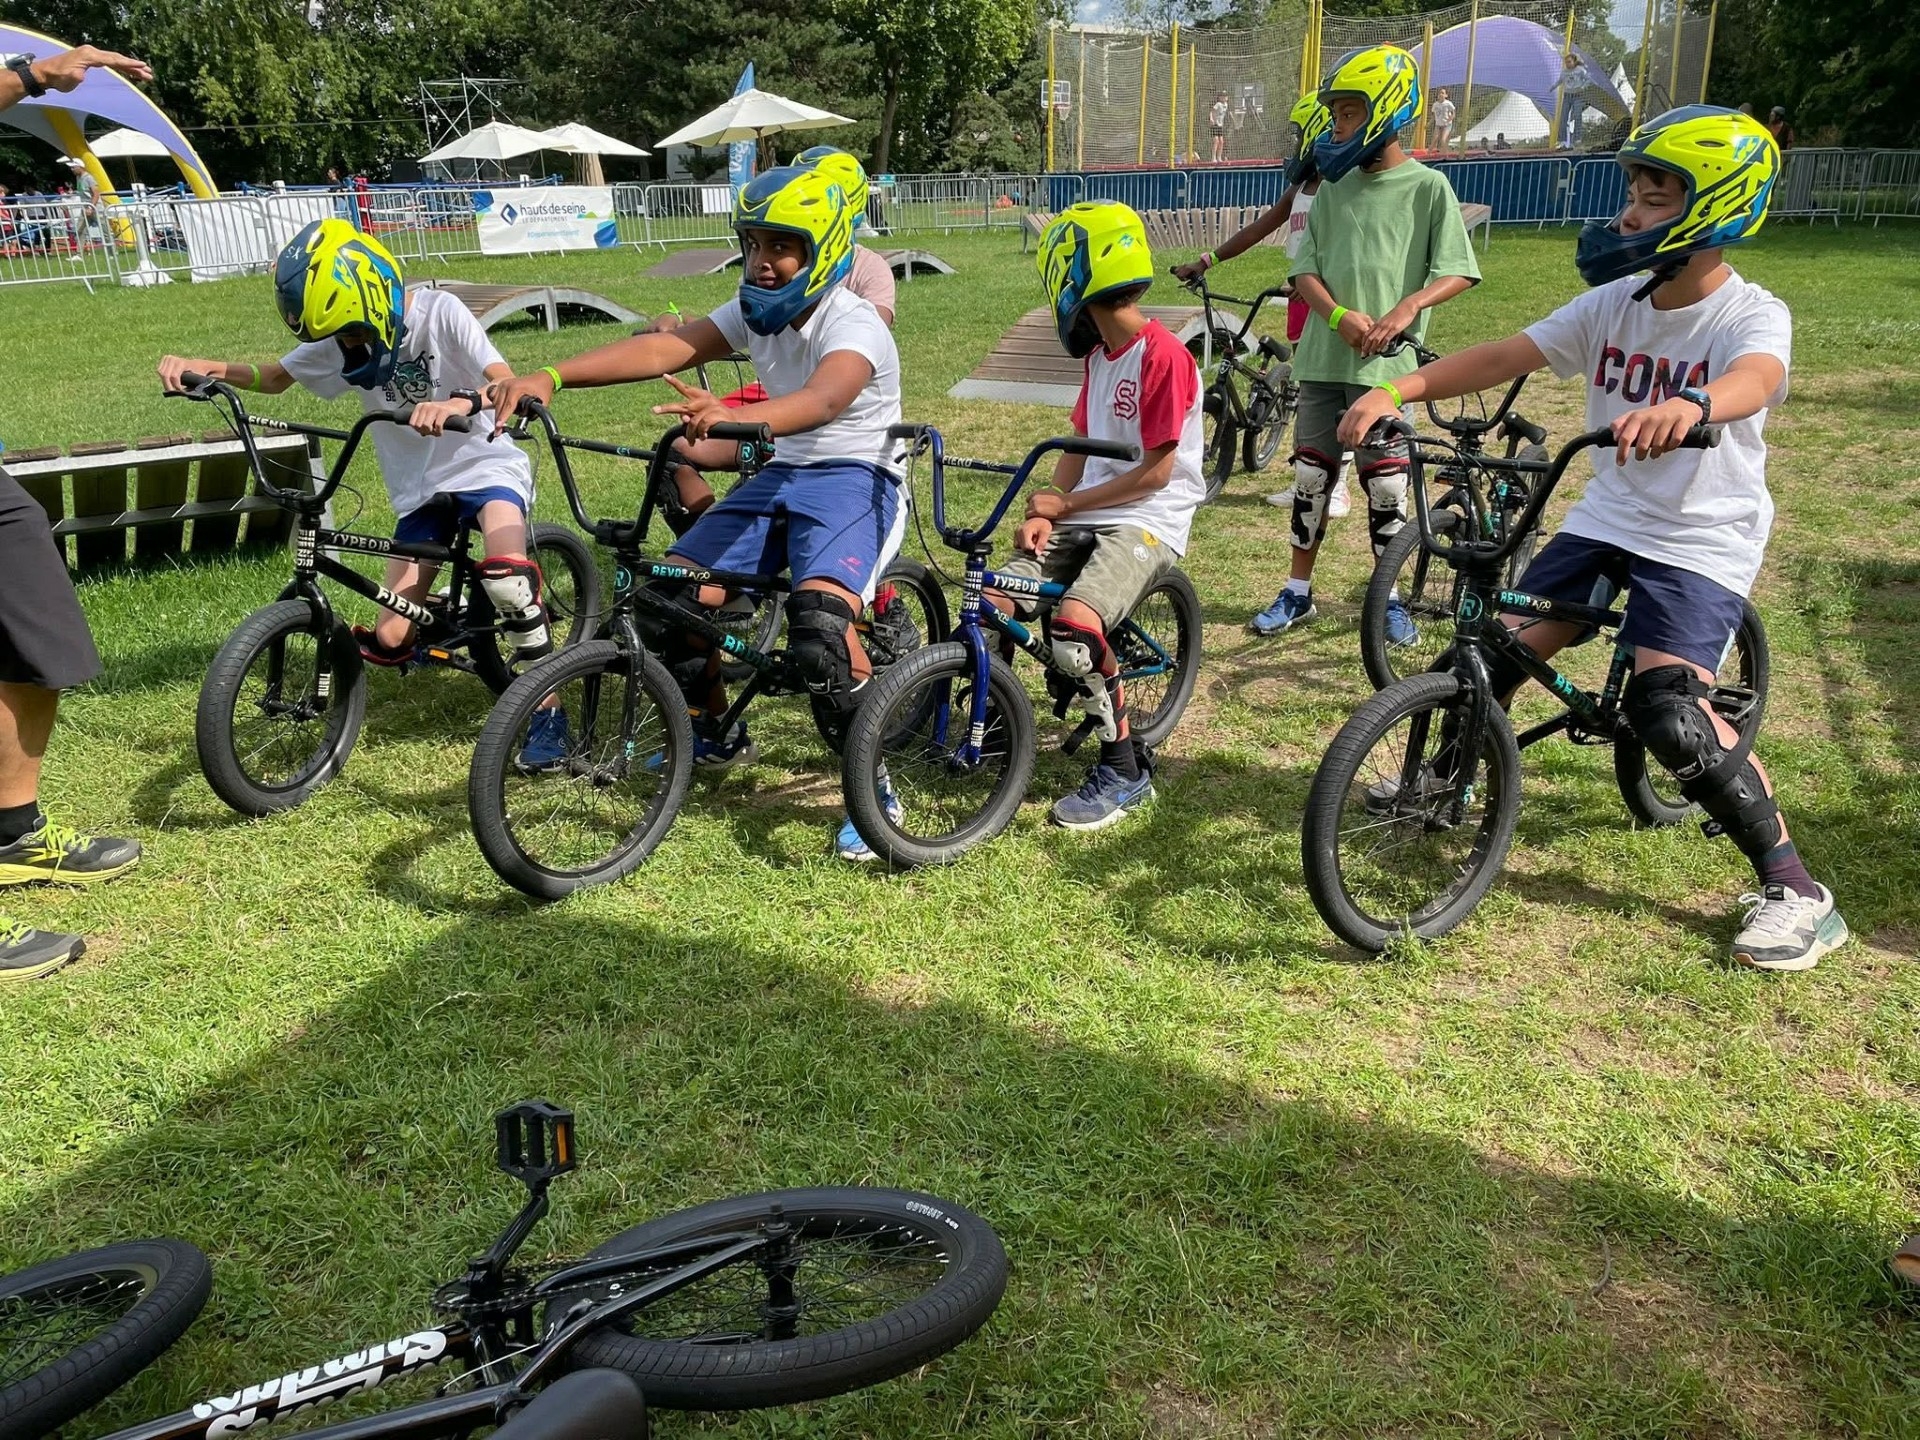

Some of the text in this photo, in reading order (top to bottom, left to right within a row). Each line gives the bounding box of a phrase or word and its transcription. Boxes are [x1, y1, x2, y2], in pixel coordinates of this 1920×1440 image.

[1114, 379, 1138, 421] S
[248, 415, 288, 431] FIEND
[375, 586, 435, 626] FIEND
